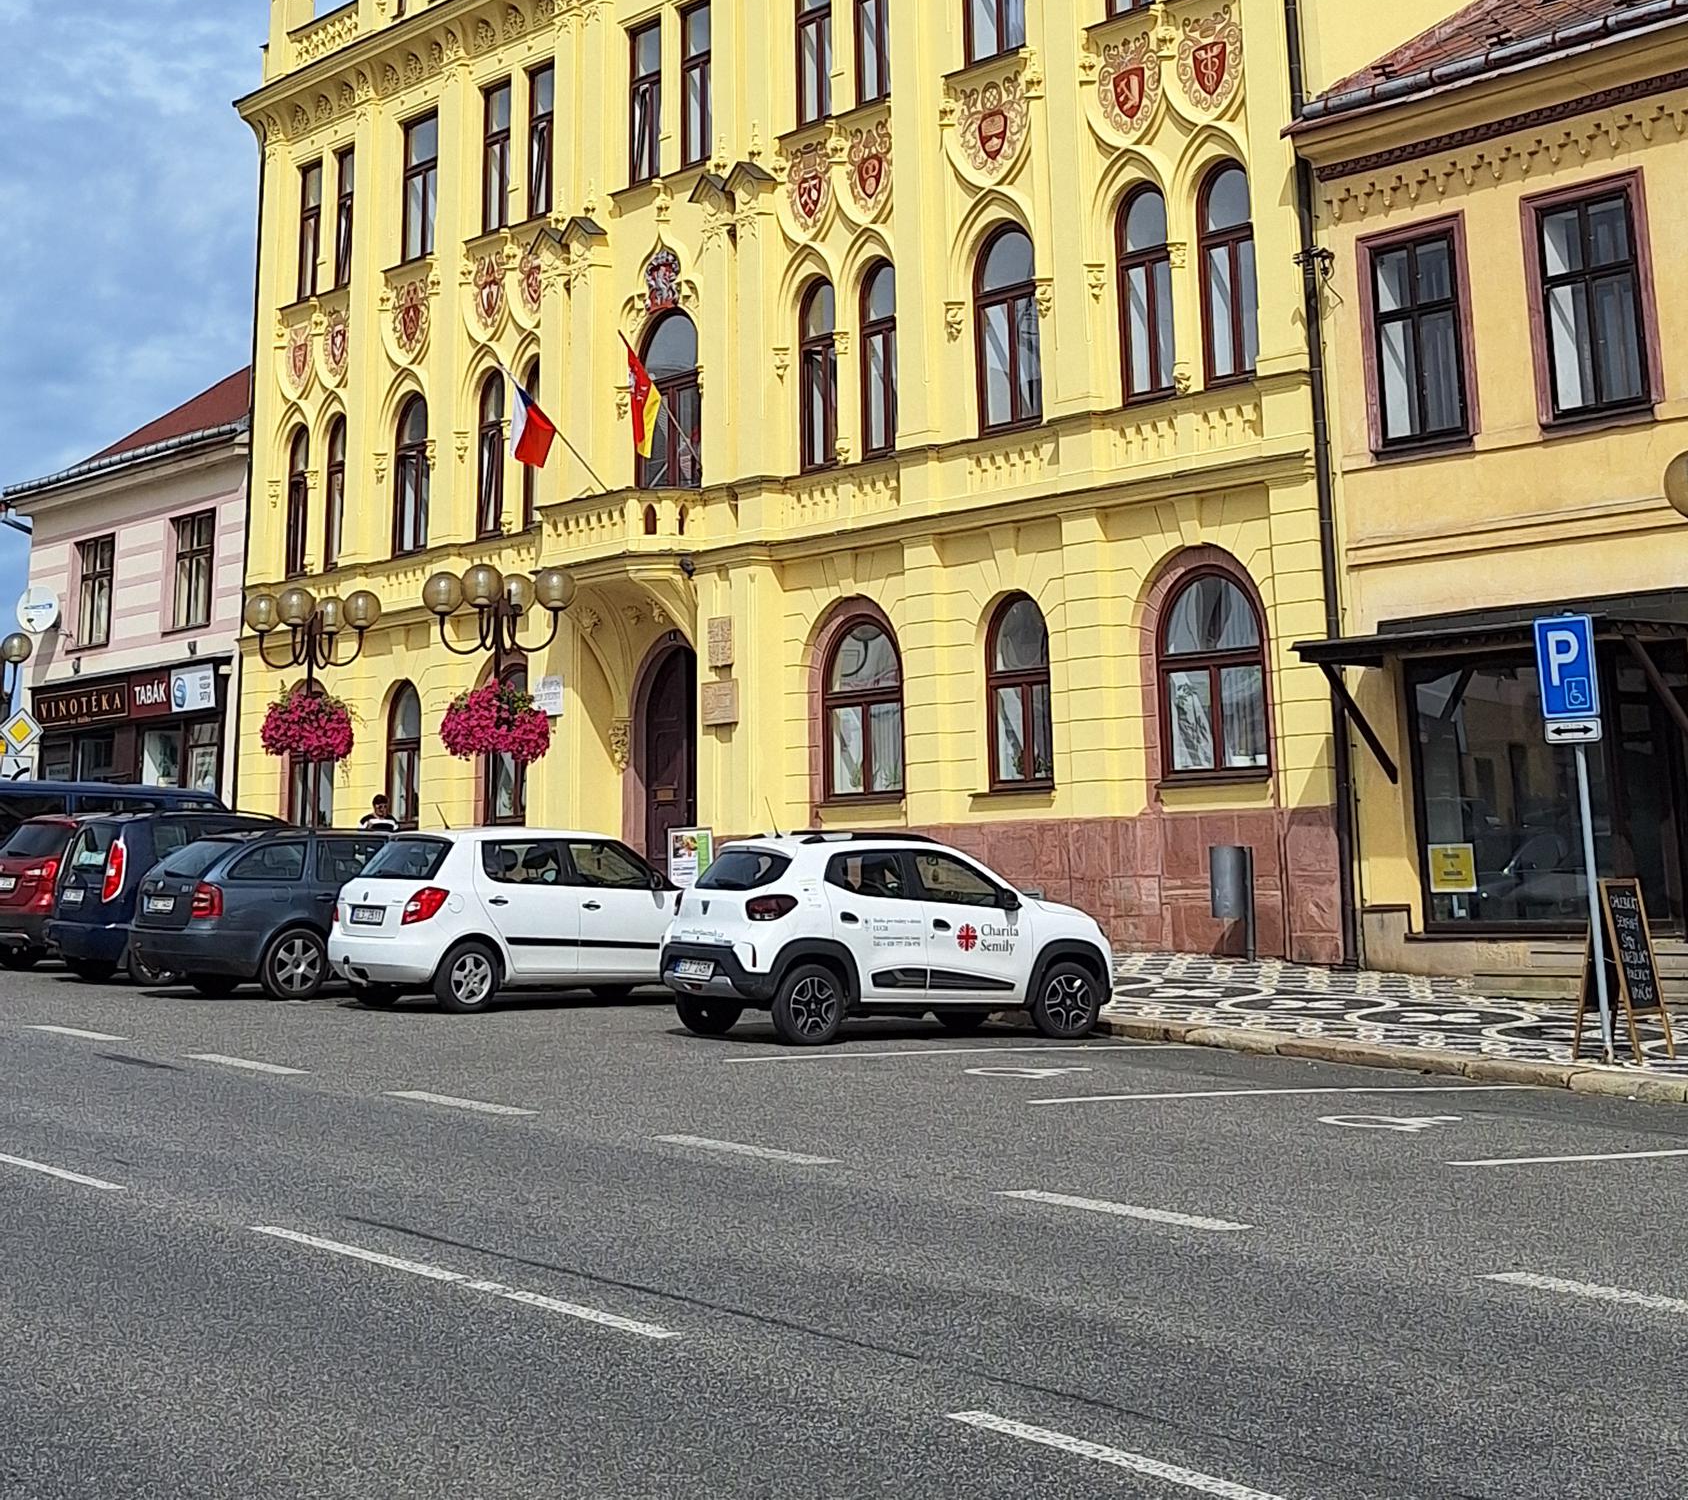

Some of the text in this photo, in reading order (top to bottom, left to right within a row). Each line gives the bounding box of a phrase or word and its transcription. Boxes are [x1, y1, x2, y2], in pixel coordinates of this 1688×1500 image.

[1547, 630, 1579, 687] P
[40, 691, 121, 719] VINOTÉKA
[134, 680, 167, 706] TABÁK
[981, 924, 1019, 937] Charita
[980, 939, 1015, 955] Semily
